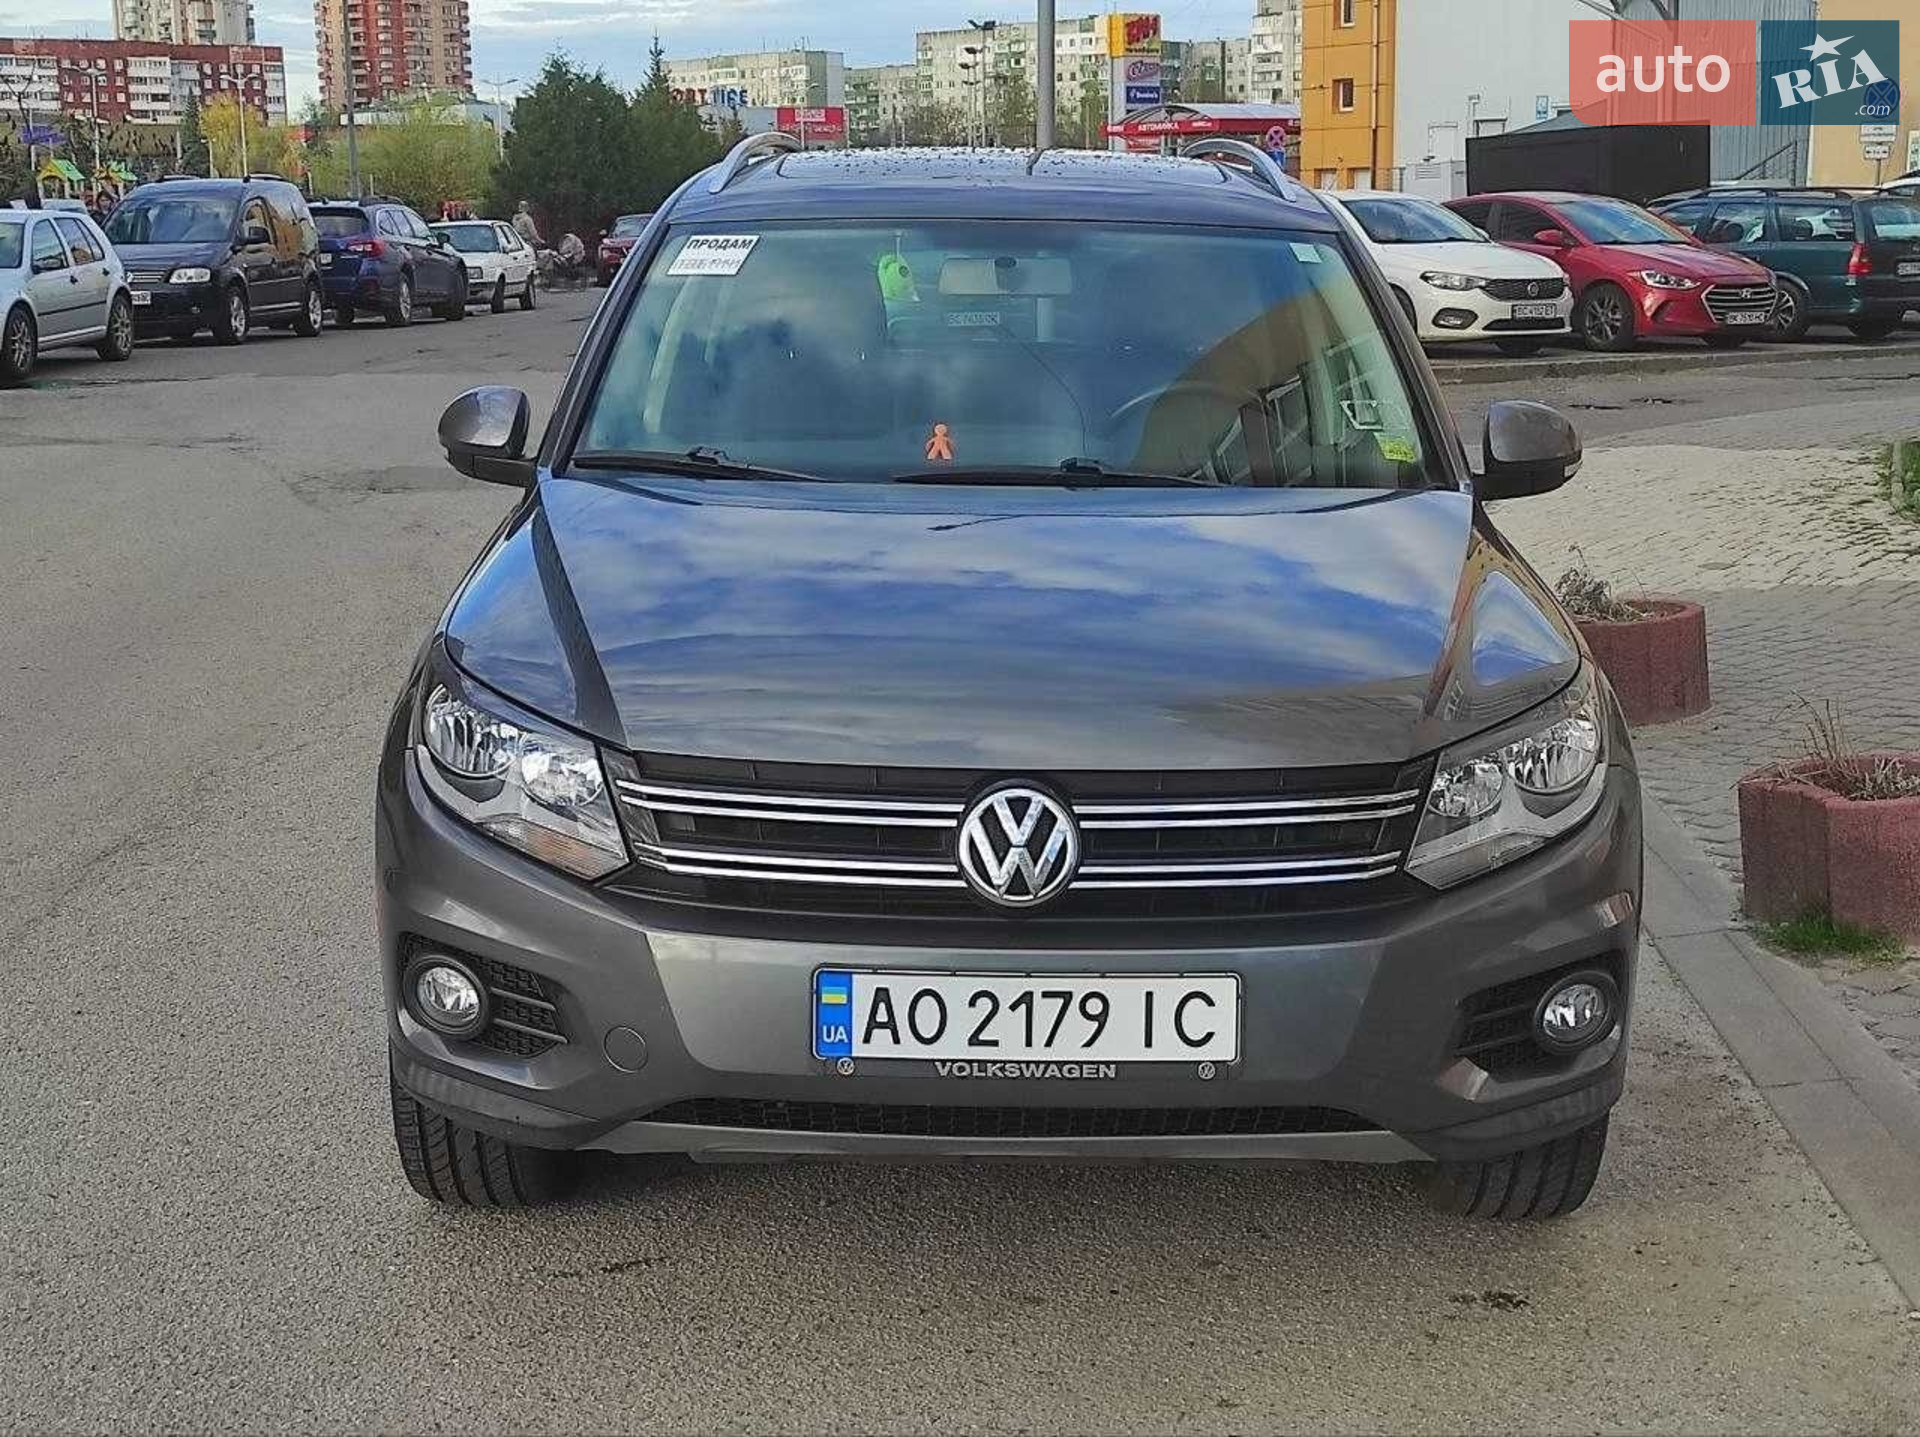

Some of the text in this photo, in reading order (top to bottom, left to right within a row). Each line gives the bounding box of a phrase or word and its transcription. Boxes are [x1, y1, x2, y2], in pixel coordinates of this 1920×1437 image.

[687, 239, 753, 250] ПРОДАМ
[862, 986, 1216, 1048] AO 2179 IC
[822, 1025, 849, 1043] UA
[934, 1061, 1117, 1079] VOLKSWAGEN
